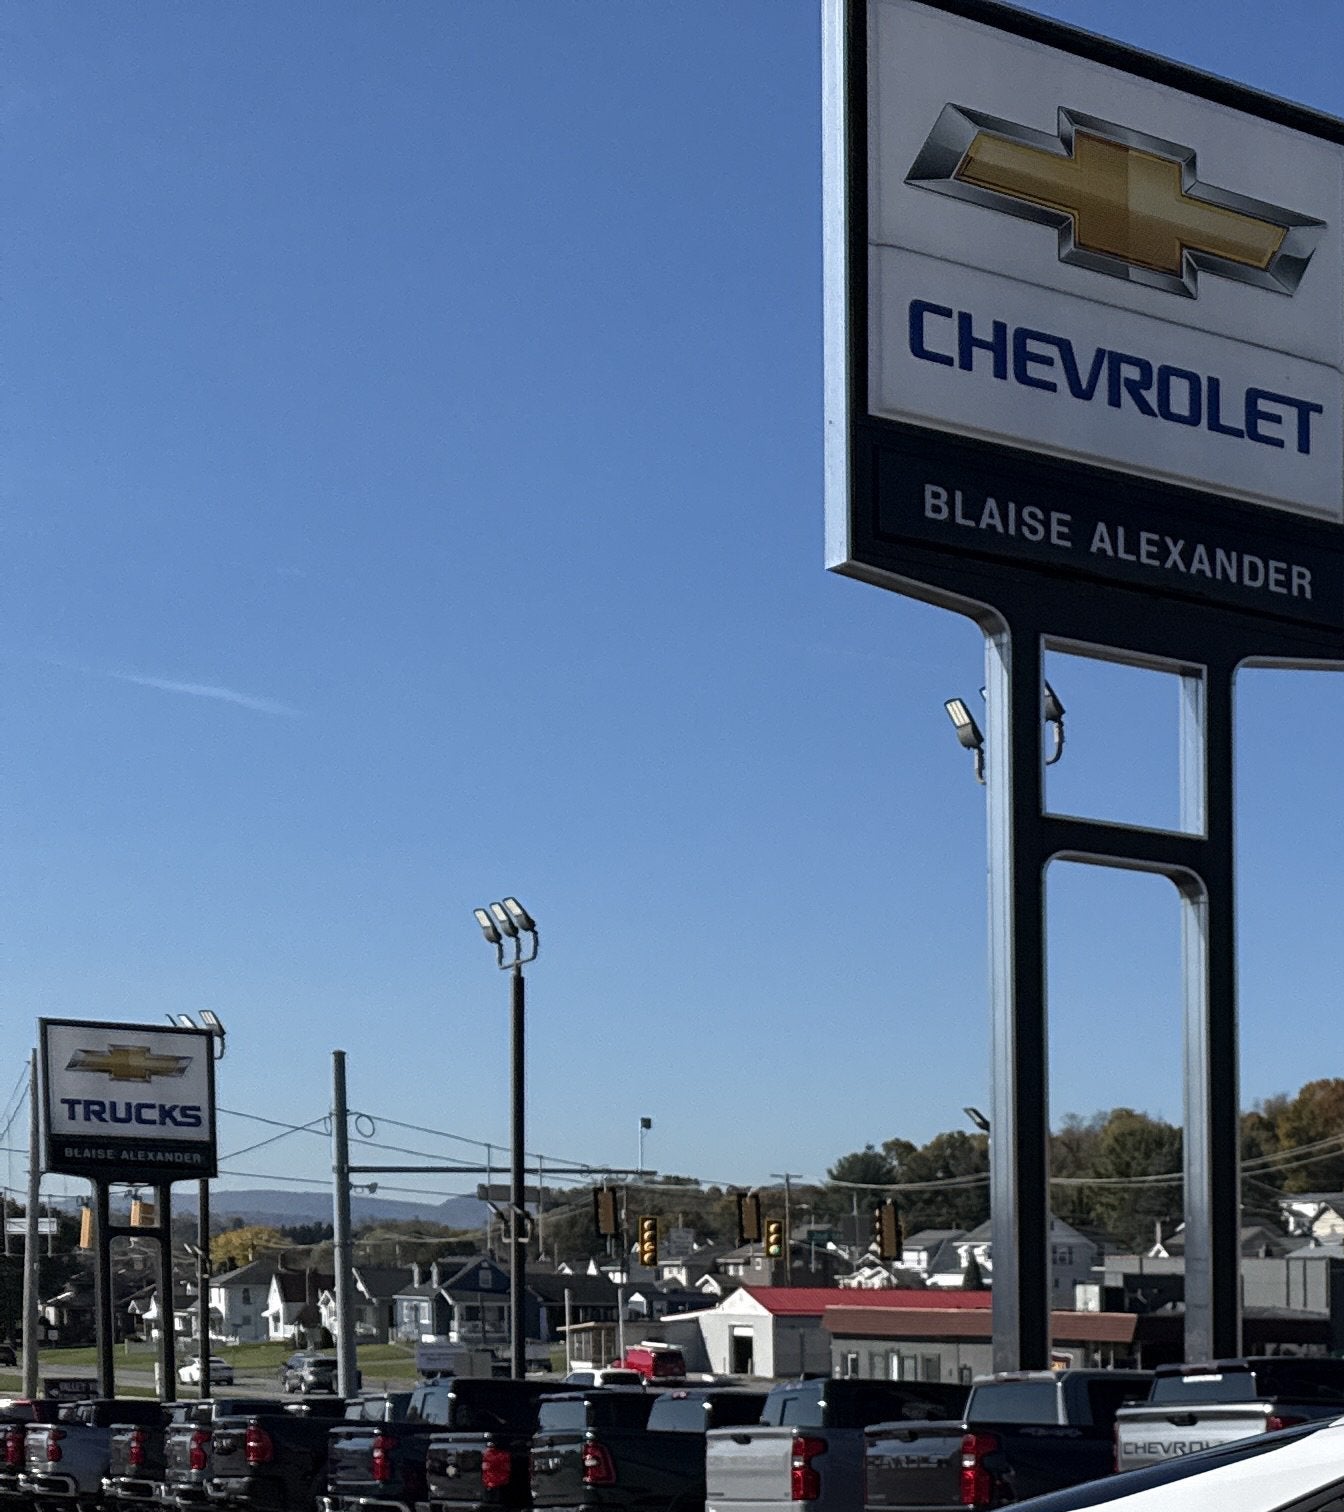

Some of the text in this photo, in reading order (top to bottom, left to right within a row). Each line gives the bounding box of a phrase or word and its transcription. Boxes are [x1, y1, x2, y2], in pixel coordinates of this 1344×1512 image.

[908, 299, 1323, 454] CHEVROLET
[924, 483, 1312, 599] BLAISE ALEXANDER
[60, 1098, 202, 1127] TRUCKS
[64, 1147, 202, 1163] BLAISE ALEXANDER
[1123, 1441, 1214, 1455] CHEVRO
